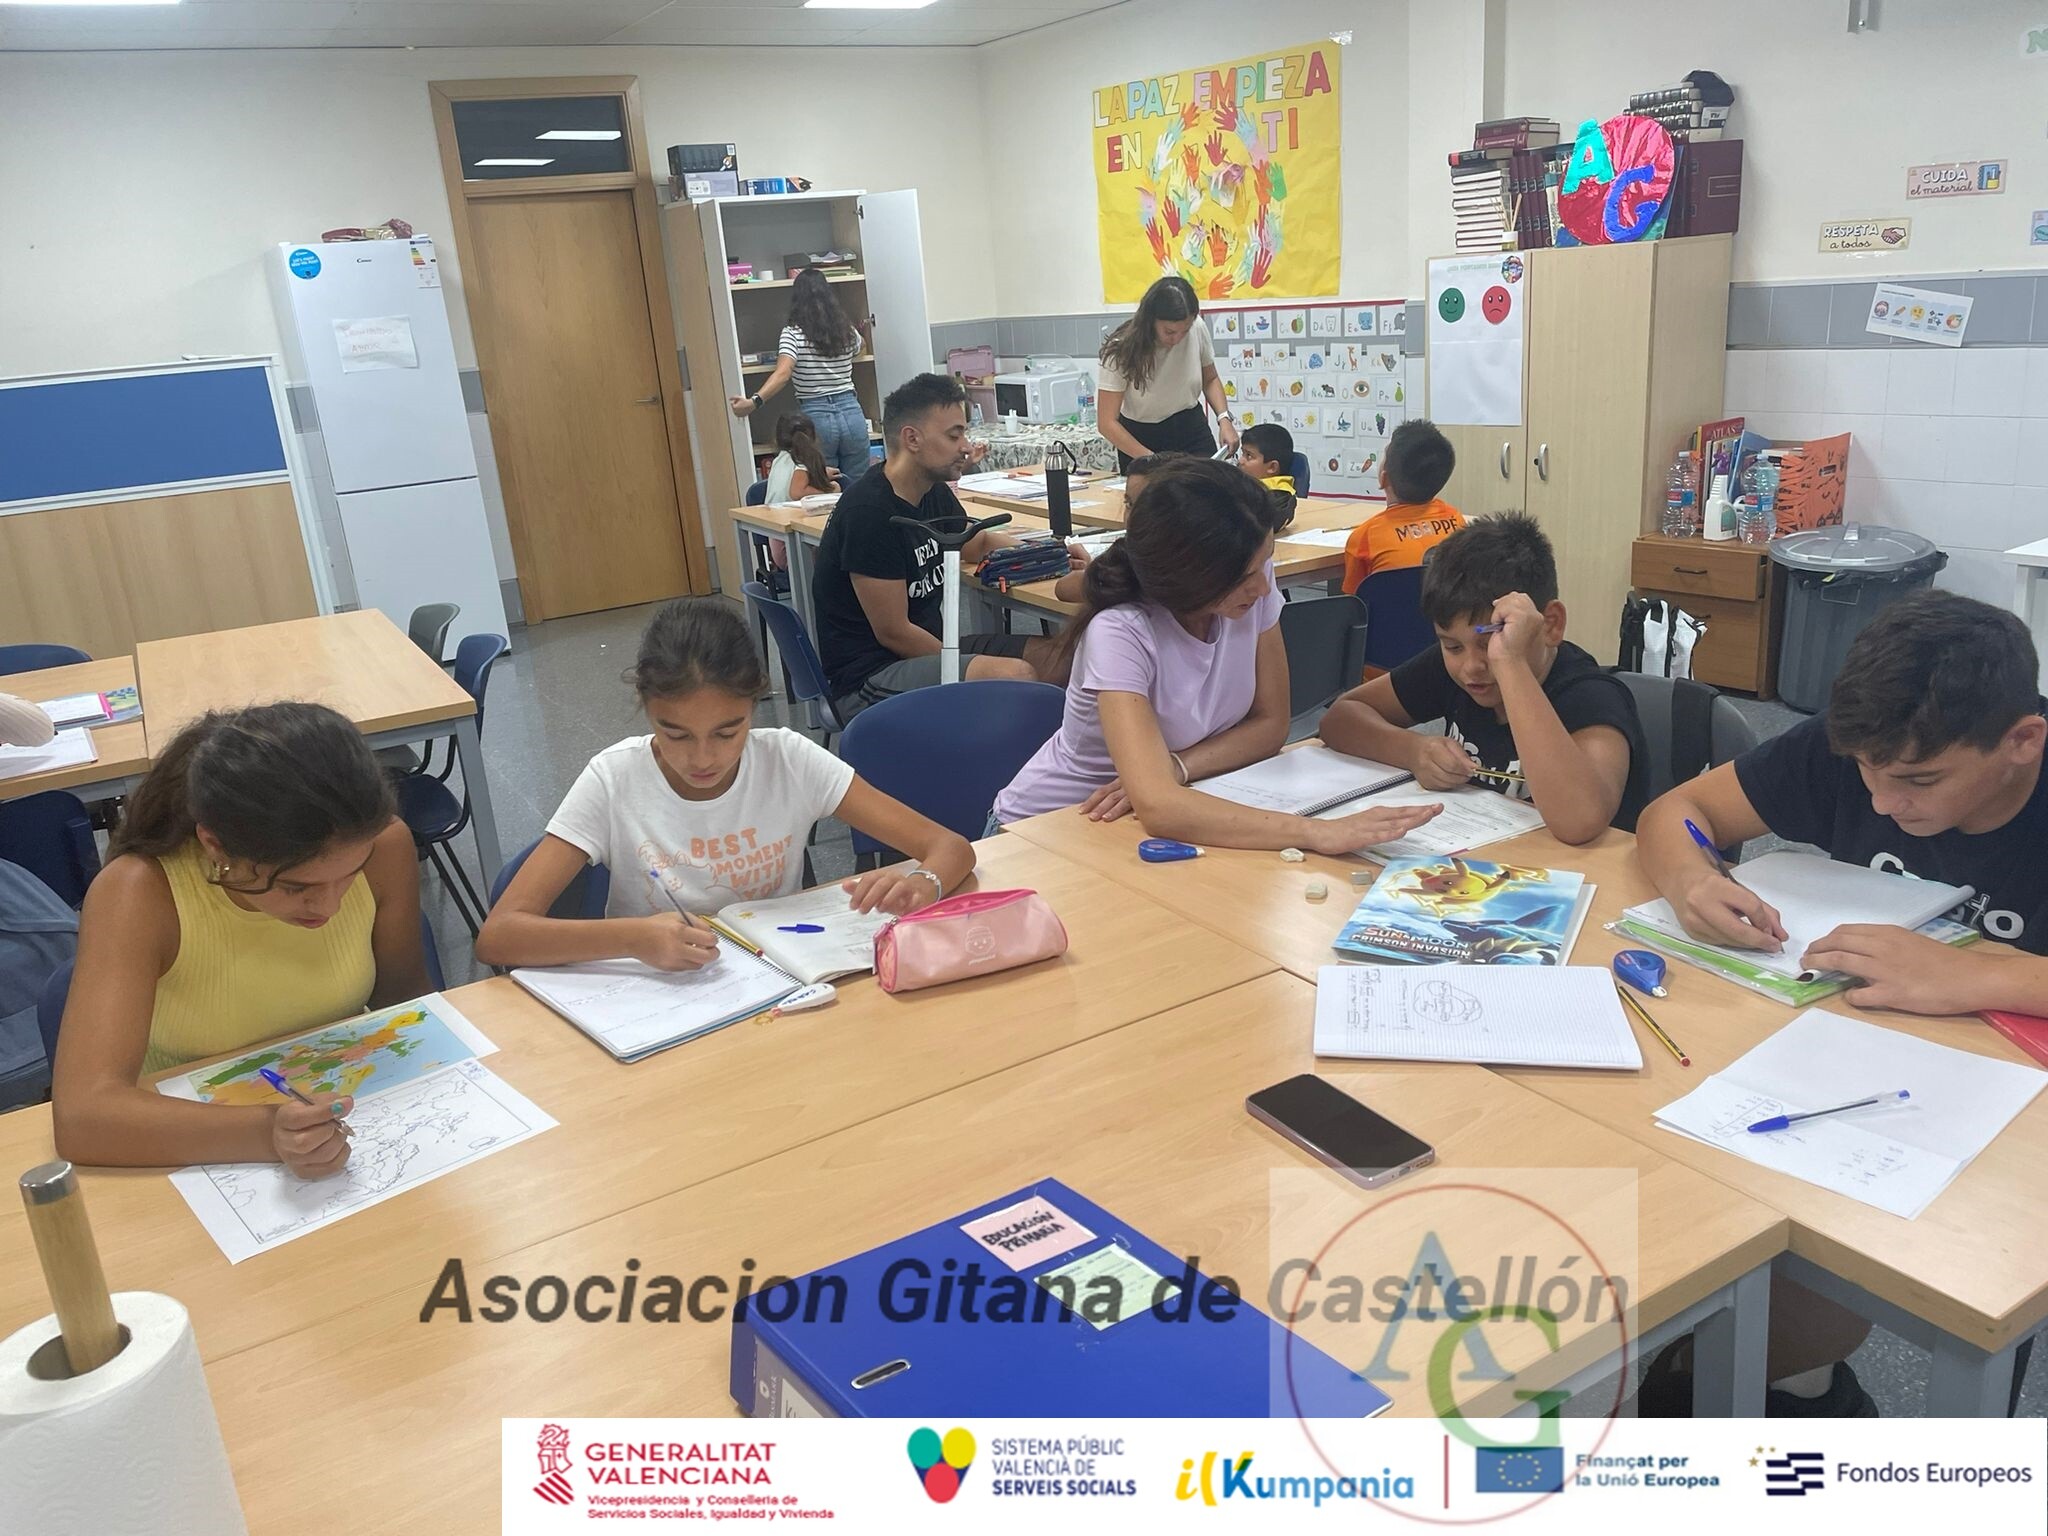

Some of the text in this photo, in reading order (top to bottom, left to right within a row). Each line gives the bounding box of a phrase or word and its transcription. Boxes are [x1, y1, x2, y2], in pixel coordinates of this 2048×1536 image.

[1194, 51, 1331, 112] EMPIEZA
[1107, 108, 1298, 173] EN TI
[1922, 168, 1968, 183] CUIDA
[1910, 181, 1973, 197] el material
[1823, 223, 1880, 239] RESPETA
[1841, 239, 1873, 249] todos
[1711, 425, 1737, 440] ATLAS
[691, 828, 758, 860] BEST
[715, 834, 793, 876] MOMENT
[730, 855, 786, 889] WITH
[1351, 934, 1471, 958] CRIMSON INVASION
